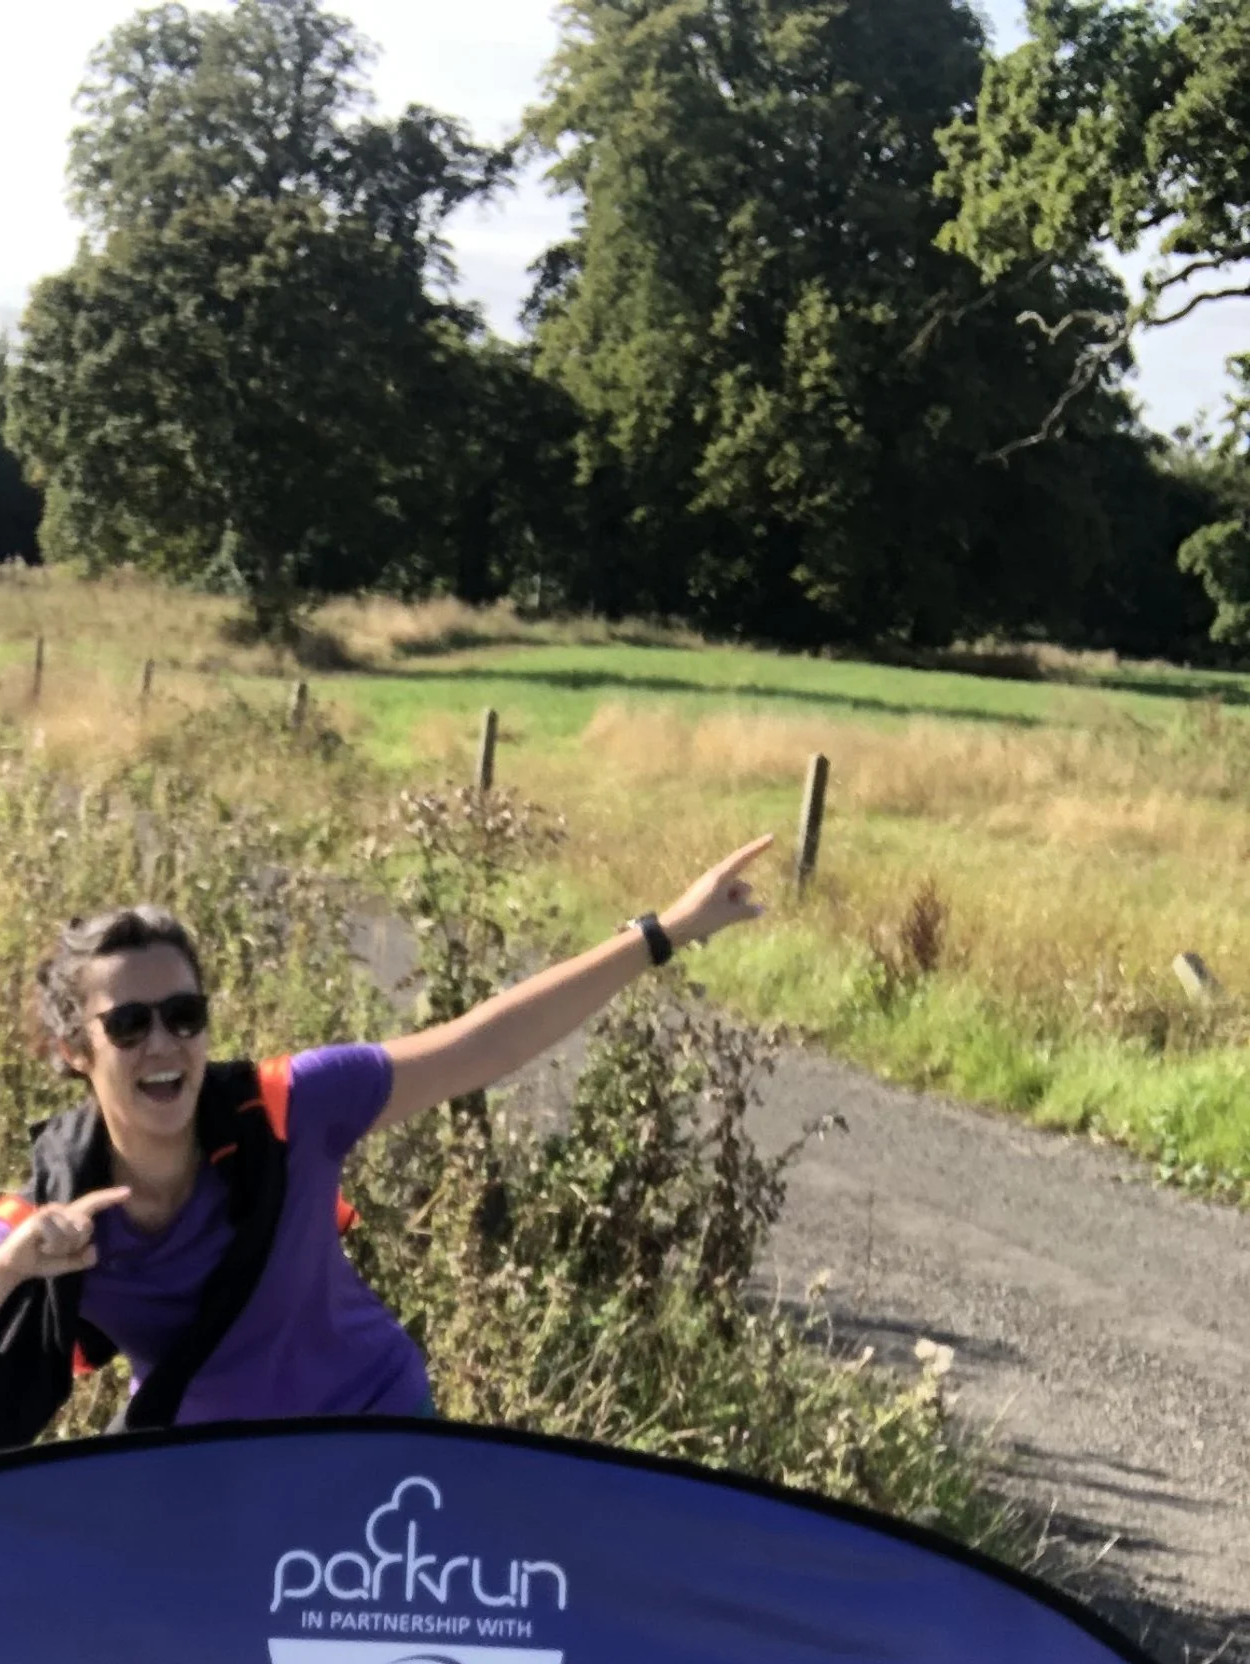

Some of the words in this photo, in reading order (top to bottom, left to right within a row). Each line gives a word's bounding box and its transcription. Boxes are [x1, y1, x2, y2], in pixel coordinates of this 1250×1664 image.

[269, 1518, 567, 1612] parkrun
[301, 1610, 323, 1630] IN
[329, 1611, 471, 1636] PARTNERSHIP
[476, 1617, 534, 1639] WITH
